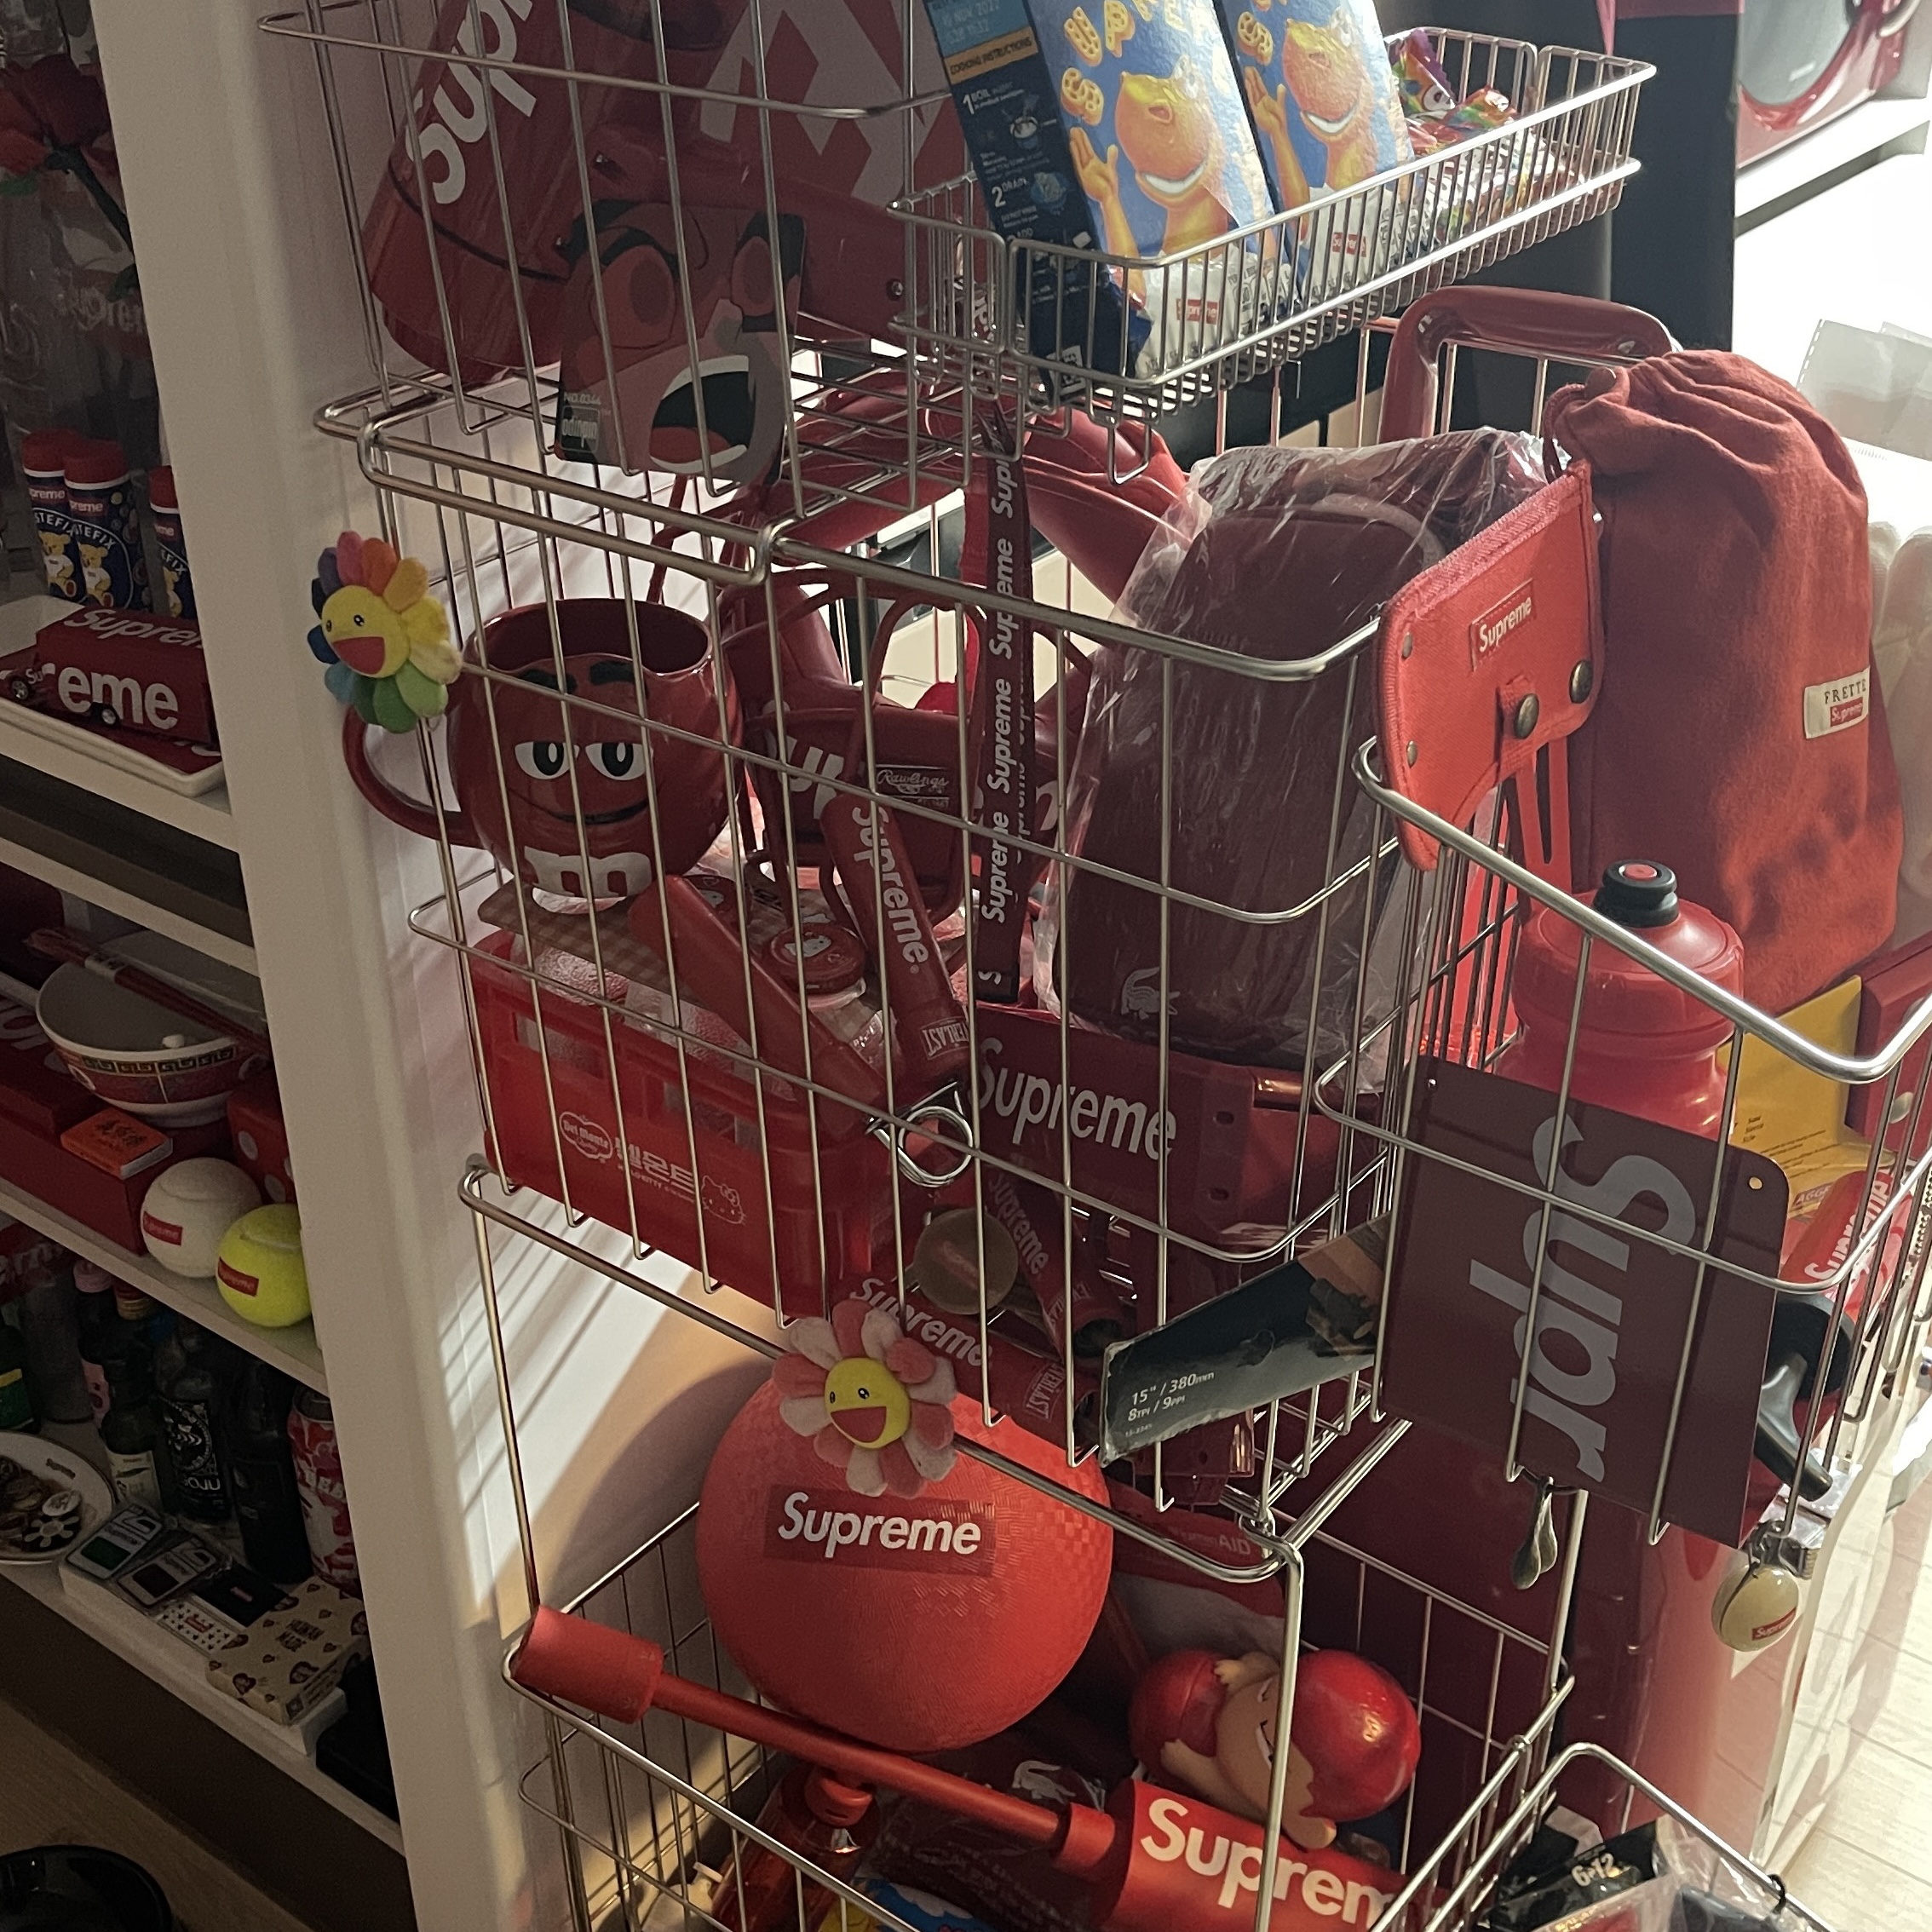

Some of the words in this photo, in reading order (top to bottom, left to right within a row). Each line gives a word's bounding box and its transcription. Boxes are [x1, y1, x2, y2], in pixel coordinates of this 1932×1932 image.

[405, 0, 537, 204] Sup
[963, 94, 975, 114] 1
[992, 186, 1006, 208] 2
[989, 538, 1019, 659] Supeme
[1479, 596, 1532, 653] Supreme
[1824, 678, 1866, 704] FRETTE
[987, 678, 1017, 794] Supreme
[877, 769, 949, 787] Rawlings
[852, 806, 929, 963] Supreme
[968, 1038, 1176, 1160] Supreme
[579, 1127, 609, 1150] Monte
[988, 1173, 1049, 1274] Supreme
[1127, 1407, 1151, 1422] 8TPI
[1162, 1395, 1186, 1410] 9PPI
[1131, 1385, 1157, 1406] 15"
[1169, 1371, 1215, 1393] 380mm
[778, 1492, 981, 1559] Supreme
[1141, 1797, 1397, 1932] Suprem
